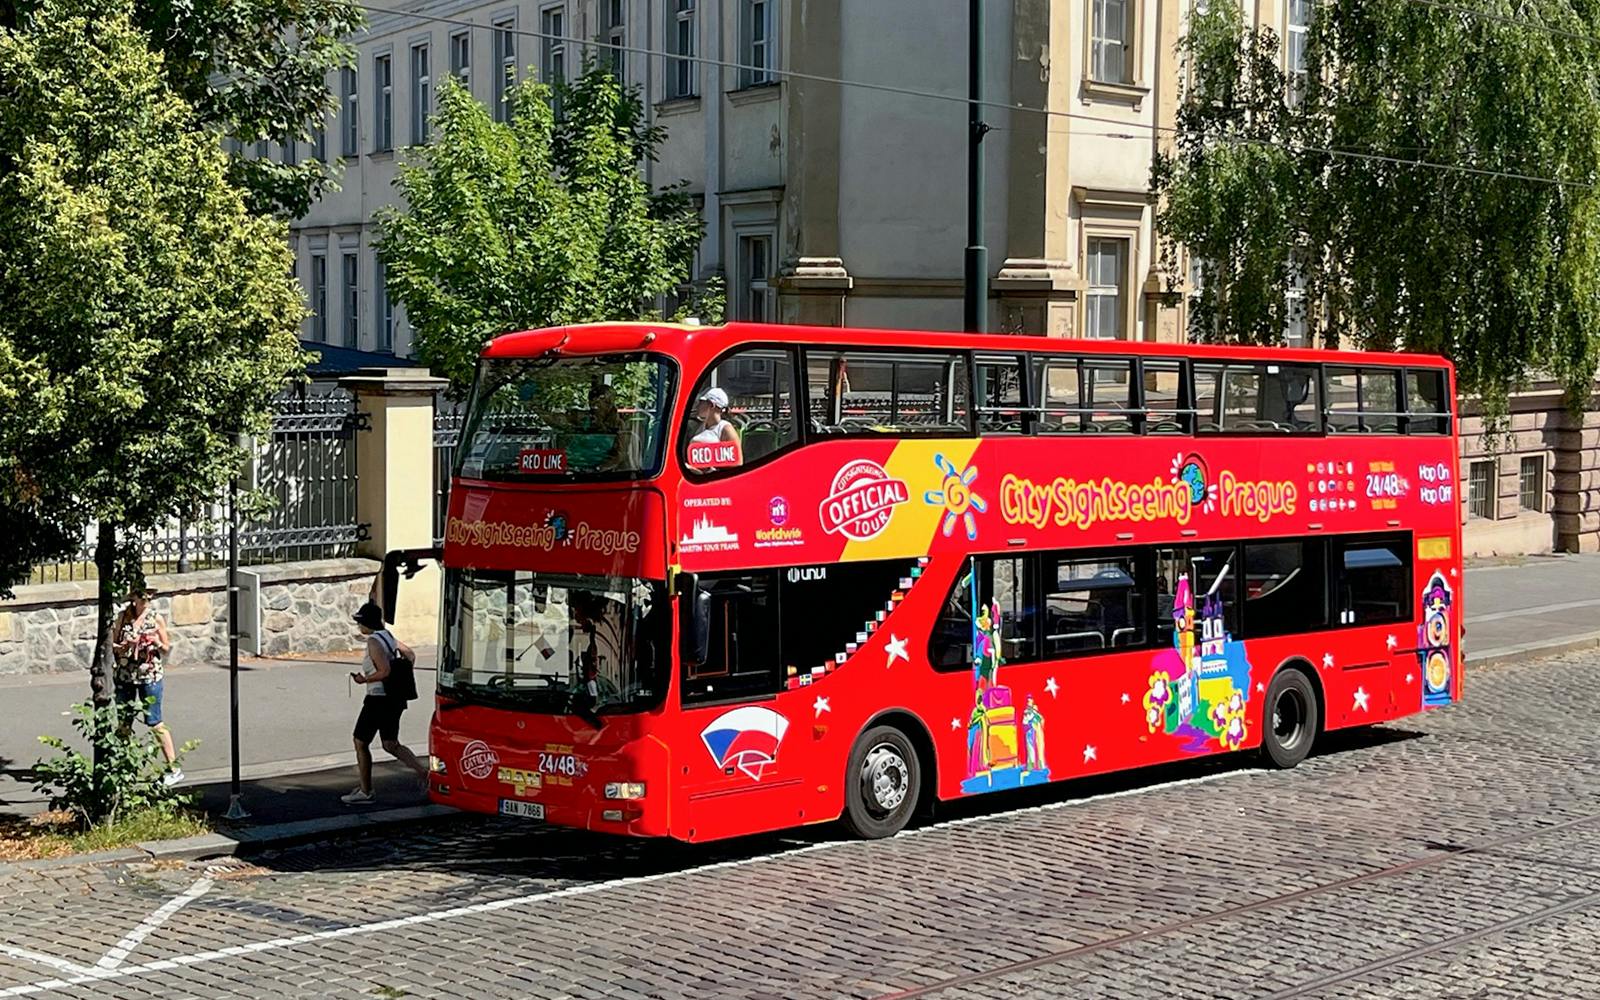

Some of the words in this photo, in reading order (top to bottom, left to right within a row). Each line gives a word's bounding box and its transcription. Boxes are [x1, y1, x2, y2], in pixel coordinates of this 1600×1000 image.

[522, 454, 541, 470] RED
[543, 454, 563, 470] LINE
[691, 446, 712, 464] RED
[715, 446, 736, 462] LINE
[1418, 464, 1436, 482] Hop
[1437, 463, 1450, 481] On
[683, 498, 720, 508] OPERATED
[828, 482, 905, 525] OFFICIAL
[1219, 470, 1297, 523] Prague
[1420, 486, 1437, 505] Hop
[1438, 485, 1453, 503] Off
[855, 511, 889, 535] TOUR
[576, 521, 641, 556] Prague
